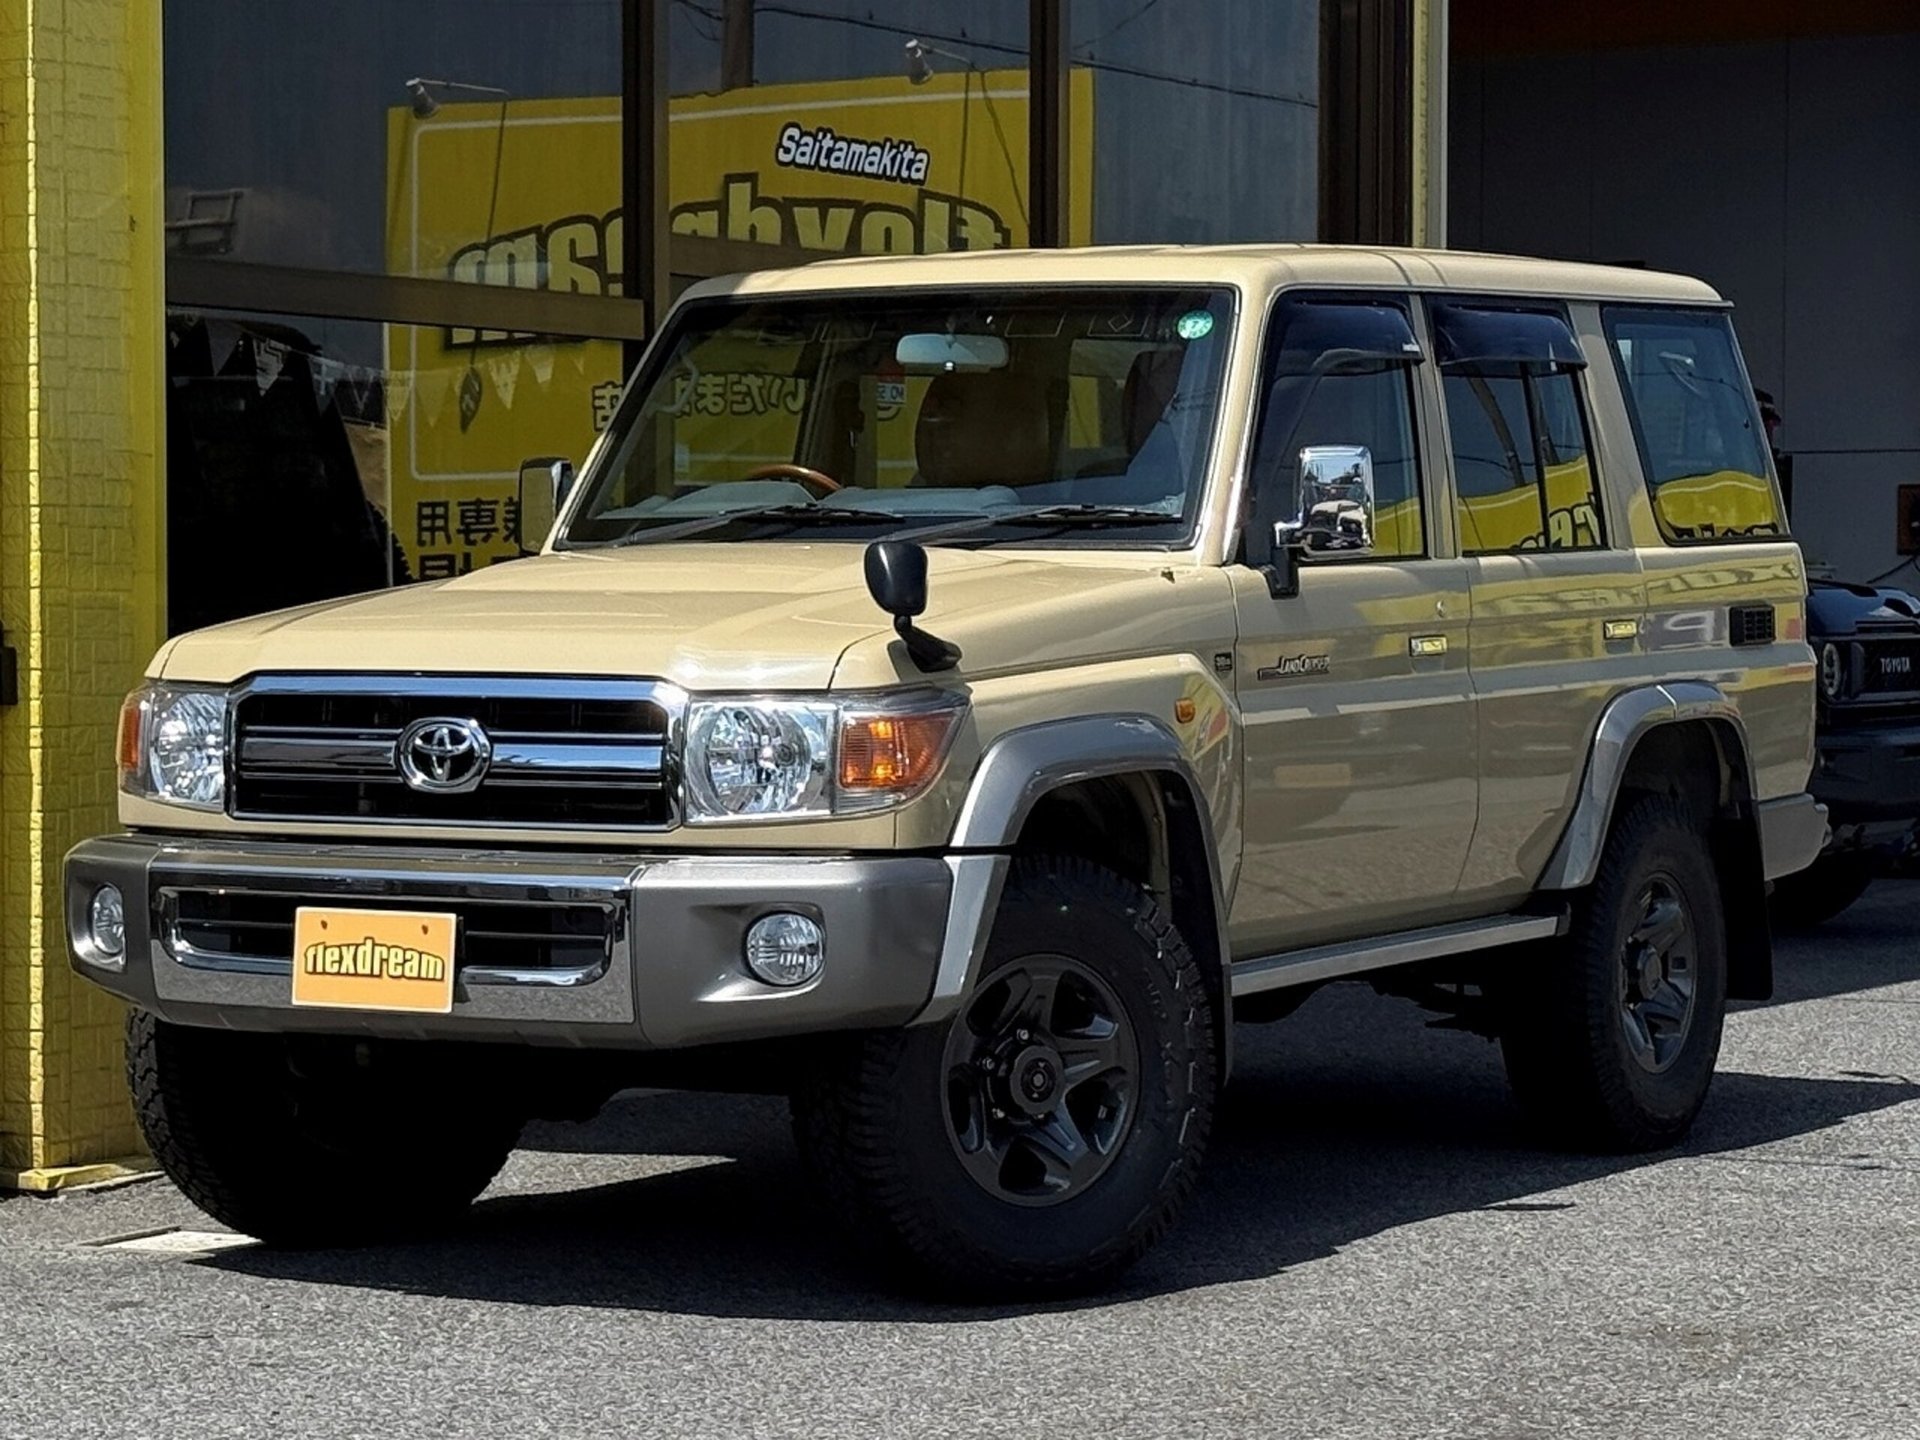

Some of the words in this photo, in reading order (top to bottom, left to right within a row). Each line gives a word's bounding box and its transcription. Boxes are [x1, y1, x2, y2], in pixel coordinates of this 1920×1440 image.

[777, 123, 930, 184] Saitamakita
[1880, 656, 1911, 674] TOYOTA
[304, 936, 445, 982] flexdream
